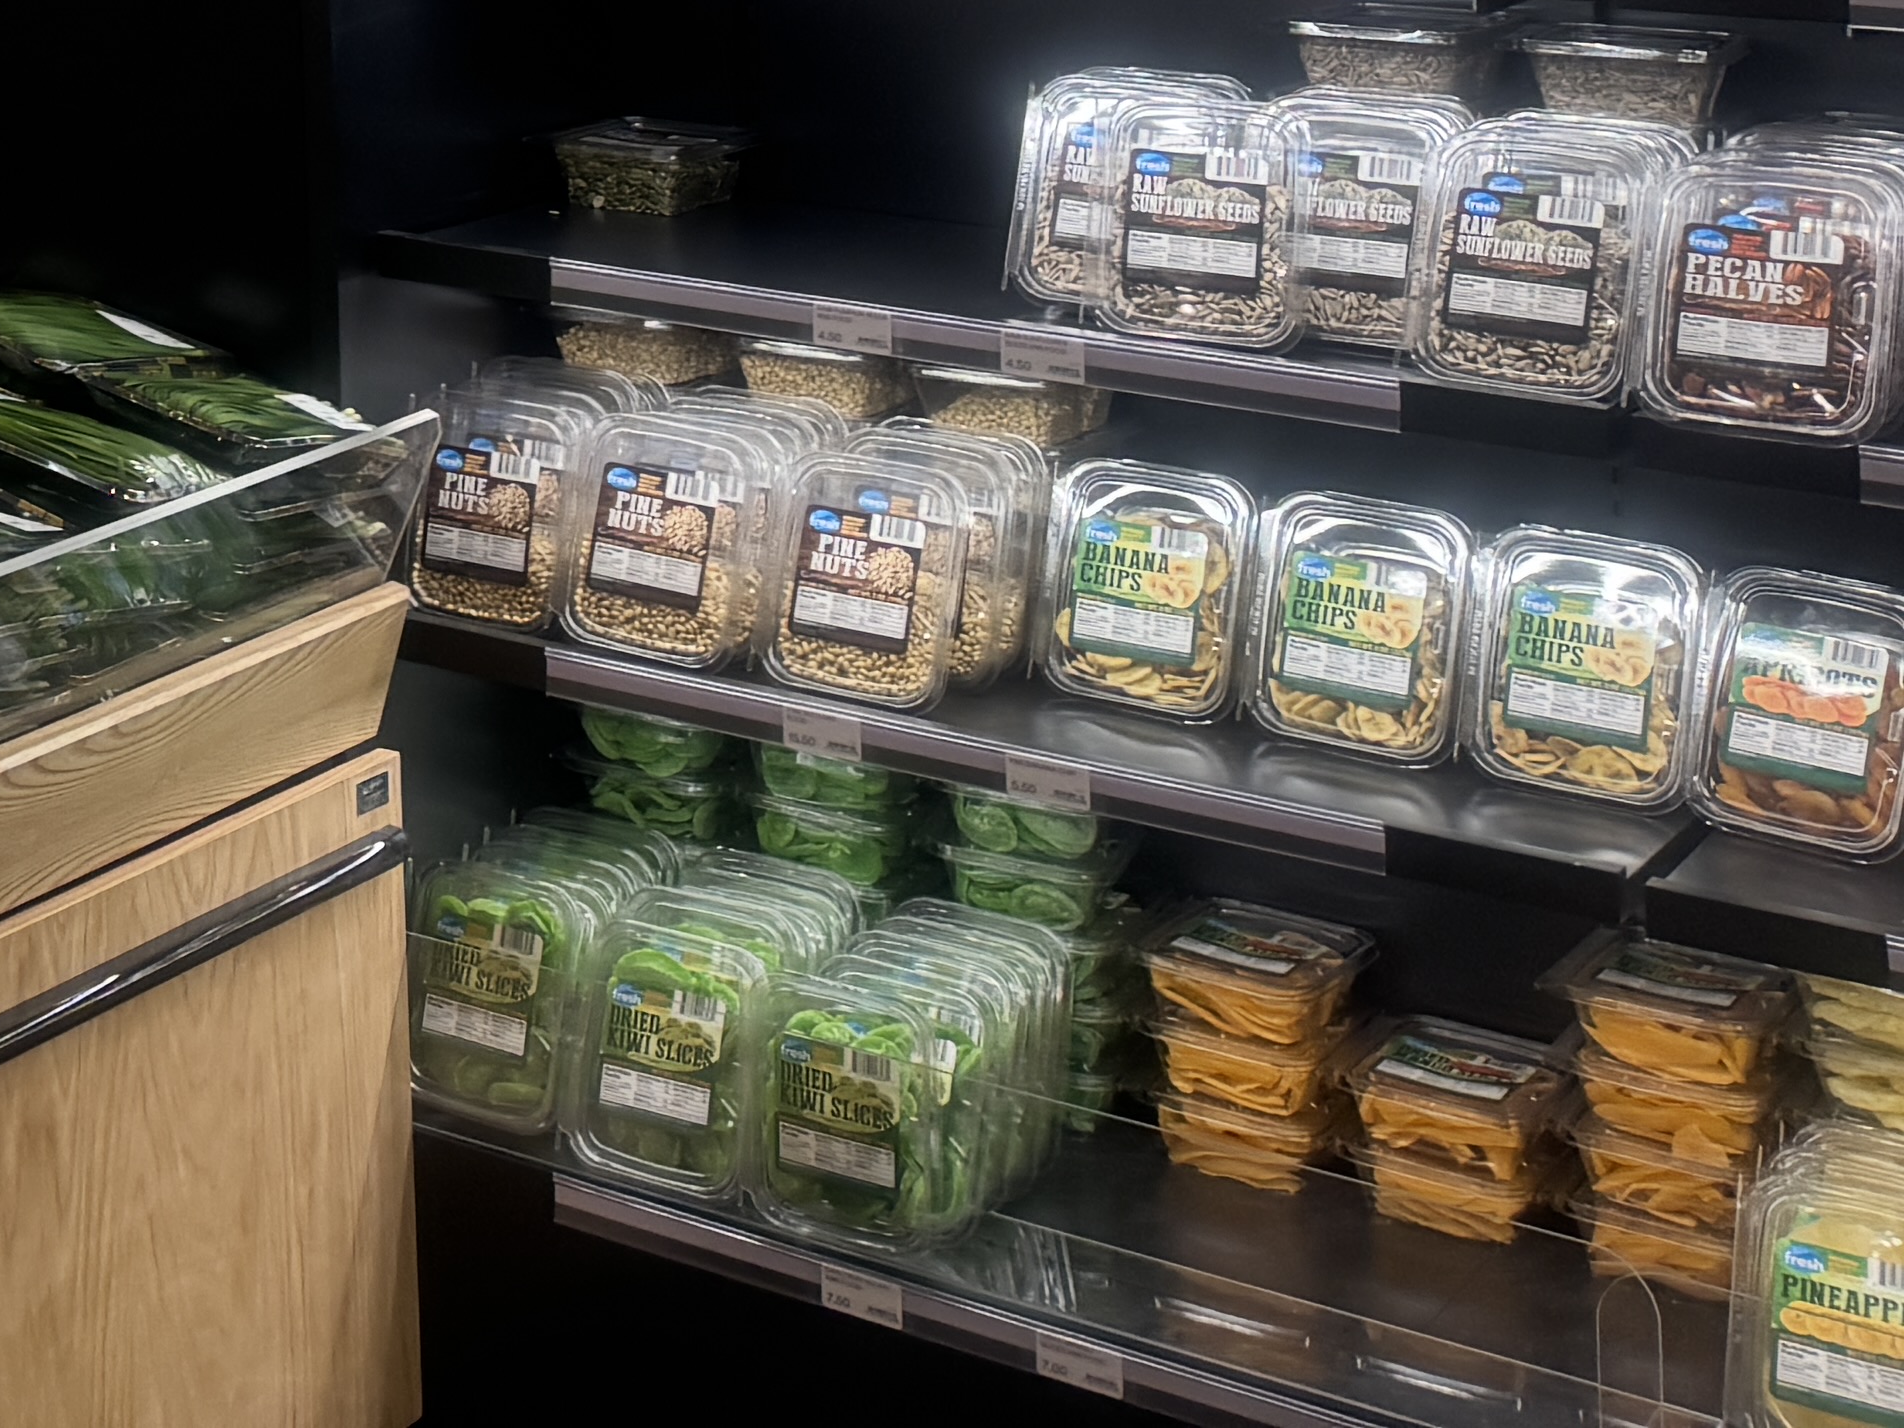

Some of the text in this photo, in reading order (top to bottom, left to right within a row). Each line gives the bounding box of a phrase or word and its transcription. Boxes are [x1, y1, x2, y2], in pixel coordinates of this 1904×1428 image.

[1132, 172, 1168, 194] RAW
[1130, 192, 1260, 224] SUNFLOWER SEEDS
[1459, 213, 1497, 237] RAW
[1455, 232, 1593, 270] SUNFLOWER SEEDS
[1686, 251, 1784, 282] PECAN
[1683, 273, 1805, 306] HALVES
[615, 491, 664, 518] PINE
[607, 508, 665, 536] NUTS
[818, 533, 868, 560] PINE
[1083, 542, 1170, 575] BANANA
[810, 551, 870, 580] NUTS
[1080, 563, 1143, 593] CHIPS
[1298, 563, 1331, 579] fresh
[1296, 577, 1387, 613] BANANA
[1291, 599, 1357, 631] CHIPS
[1519, 612, 1616, 650] BANANA
[1514, 635, 1584, 667] CHIPS
[609, 1004, 662, 1035] DRIED
[655, 1036, 715, 1068] SLICES
[781, 1059, 834, 1092] DRIED
[831, 1095, 895, 1130] SLICES
[1785, 1250, 1826, 1273] fresh
[1780, 1273, 1904, 1326] PINEAPP
